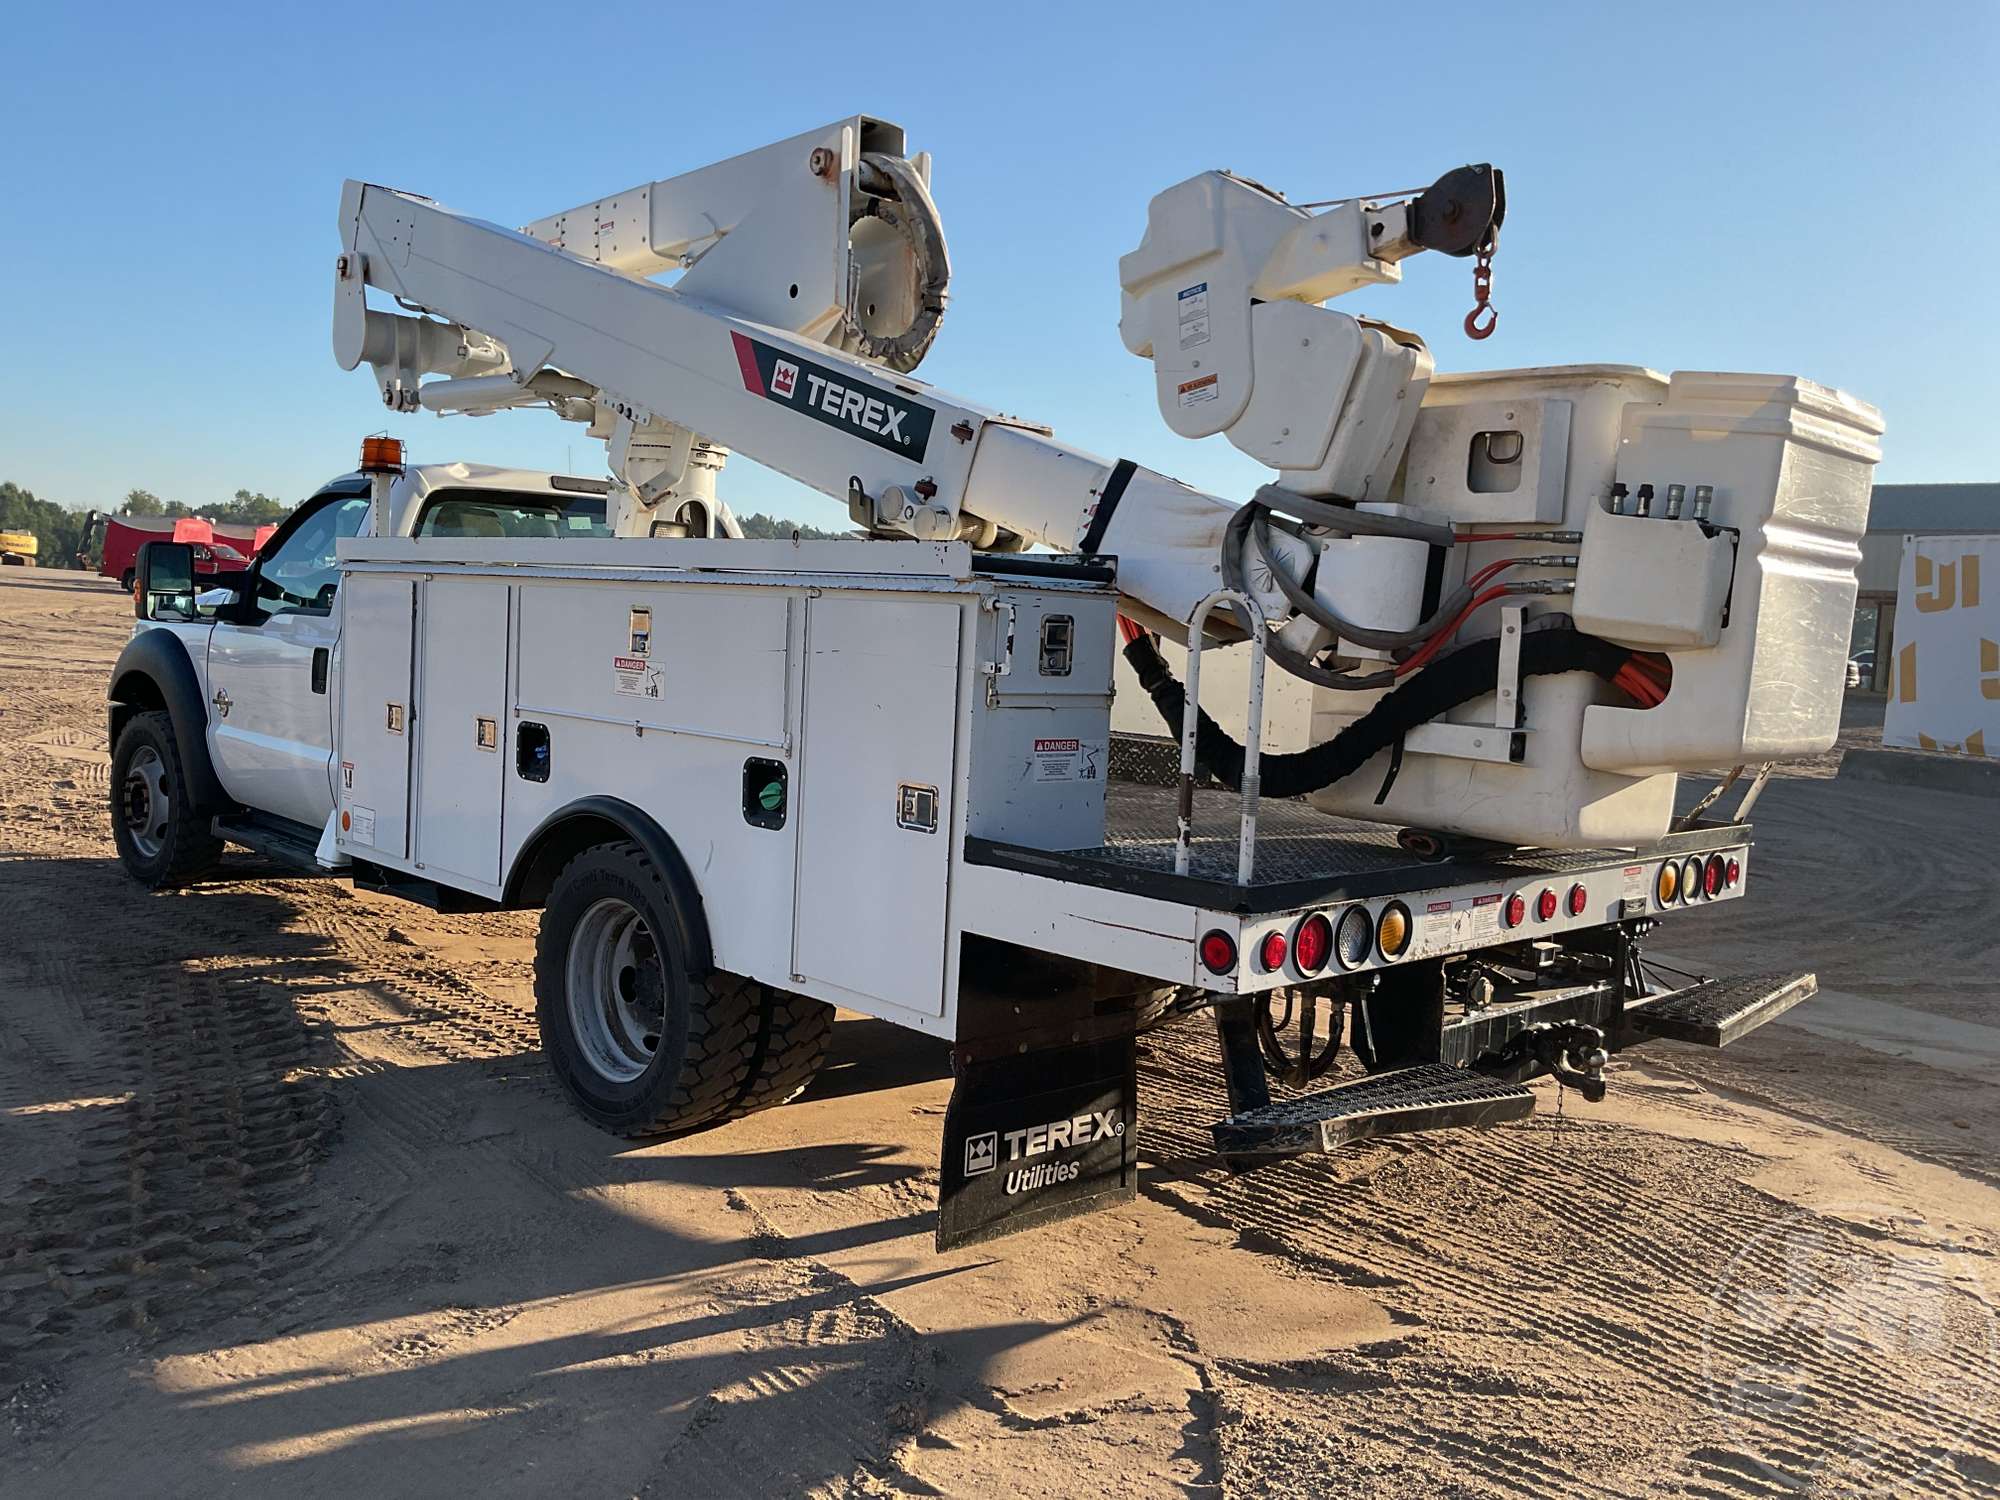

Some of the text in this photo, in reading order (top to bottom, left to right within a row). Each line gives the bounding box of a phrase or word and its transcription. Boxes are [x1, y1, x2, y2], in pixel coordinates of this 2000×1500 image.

[807, 374, 908, 443] TEREX
[621, 660, 644, 670] DANGER
[1044, 741, 1077, 751] DANGER
[1004, 1109, 1116, 1161] TEREX
[1006, 1161, 1080, 1195] Utilities
